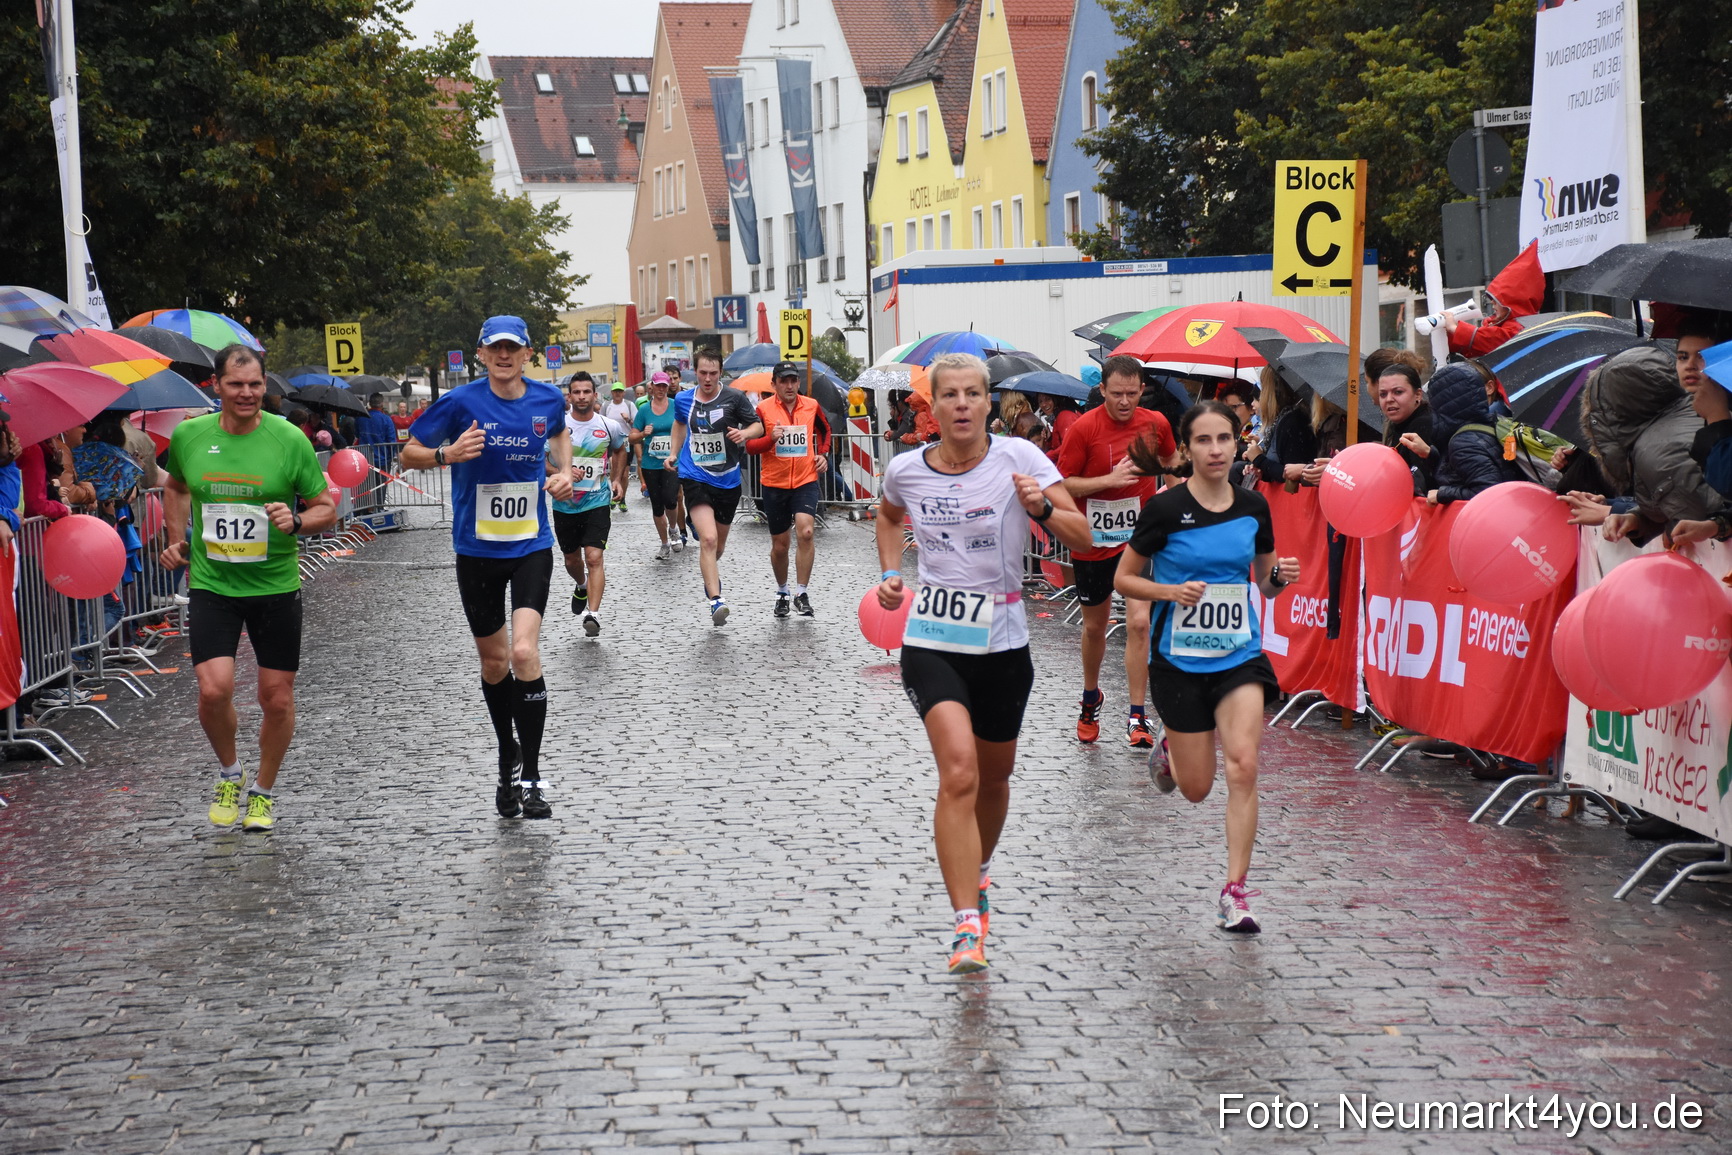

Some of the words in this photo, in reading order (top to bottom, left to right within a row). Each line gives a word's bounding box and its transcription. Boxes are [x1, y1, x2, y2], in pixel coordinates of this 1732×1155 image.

[1486, 112, 1511, 123] Ulmer
[1513, 110, 1533, 121] Gass
[1286, 166, 1355, 190] Block
[909, 186, 931, 211] HOTEL
[1295, 200, 1342, 268] C
[783, 312, 808, 321] Block
[329, 325, 357, 336] Block
[788, 325, 804, 350] D
[335, 339, 354, 365] D
[483, 422, 499, 430] MIT
[488, 435, 529, 448] JESUS
[695, 441, 722, 453] 2138
[778, 433, 806, 445] 3106
[210, 483, 254, 497] RUNNER
[490, 496, 528, 518] 600
[215, 518, 255, 540] 612
[1092, 509, 1137, 530] 2649
[917, 586, 986, 622] 3067
[1182, 602, 1243, 630] 2009
[1184, 635, 1238, 649] CAROLIN
